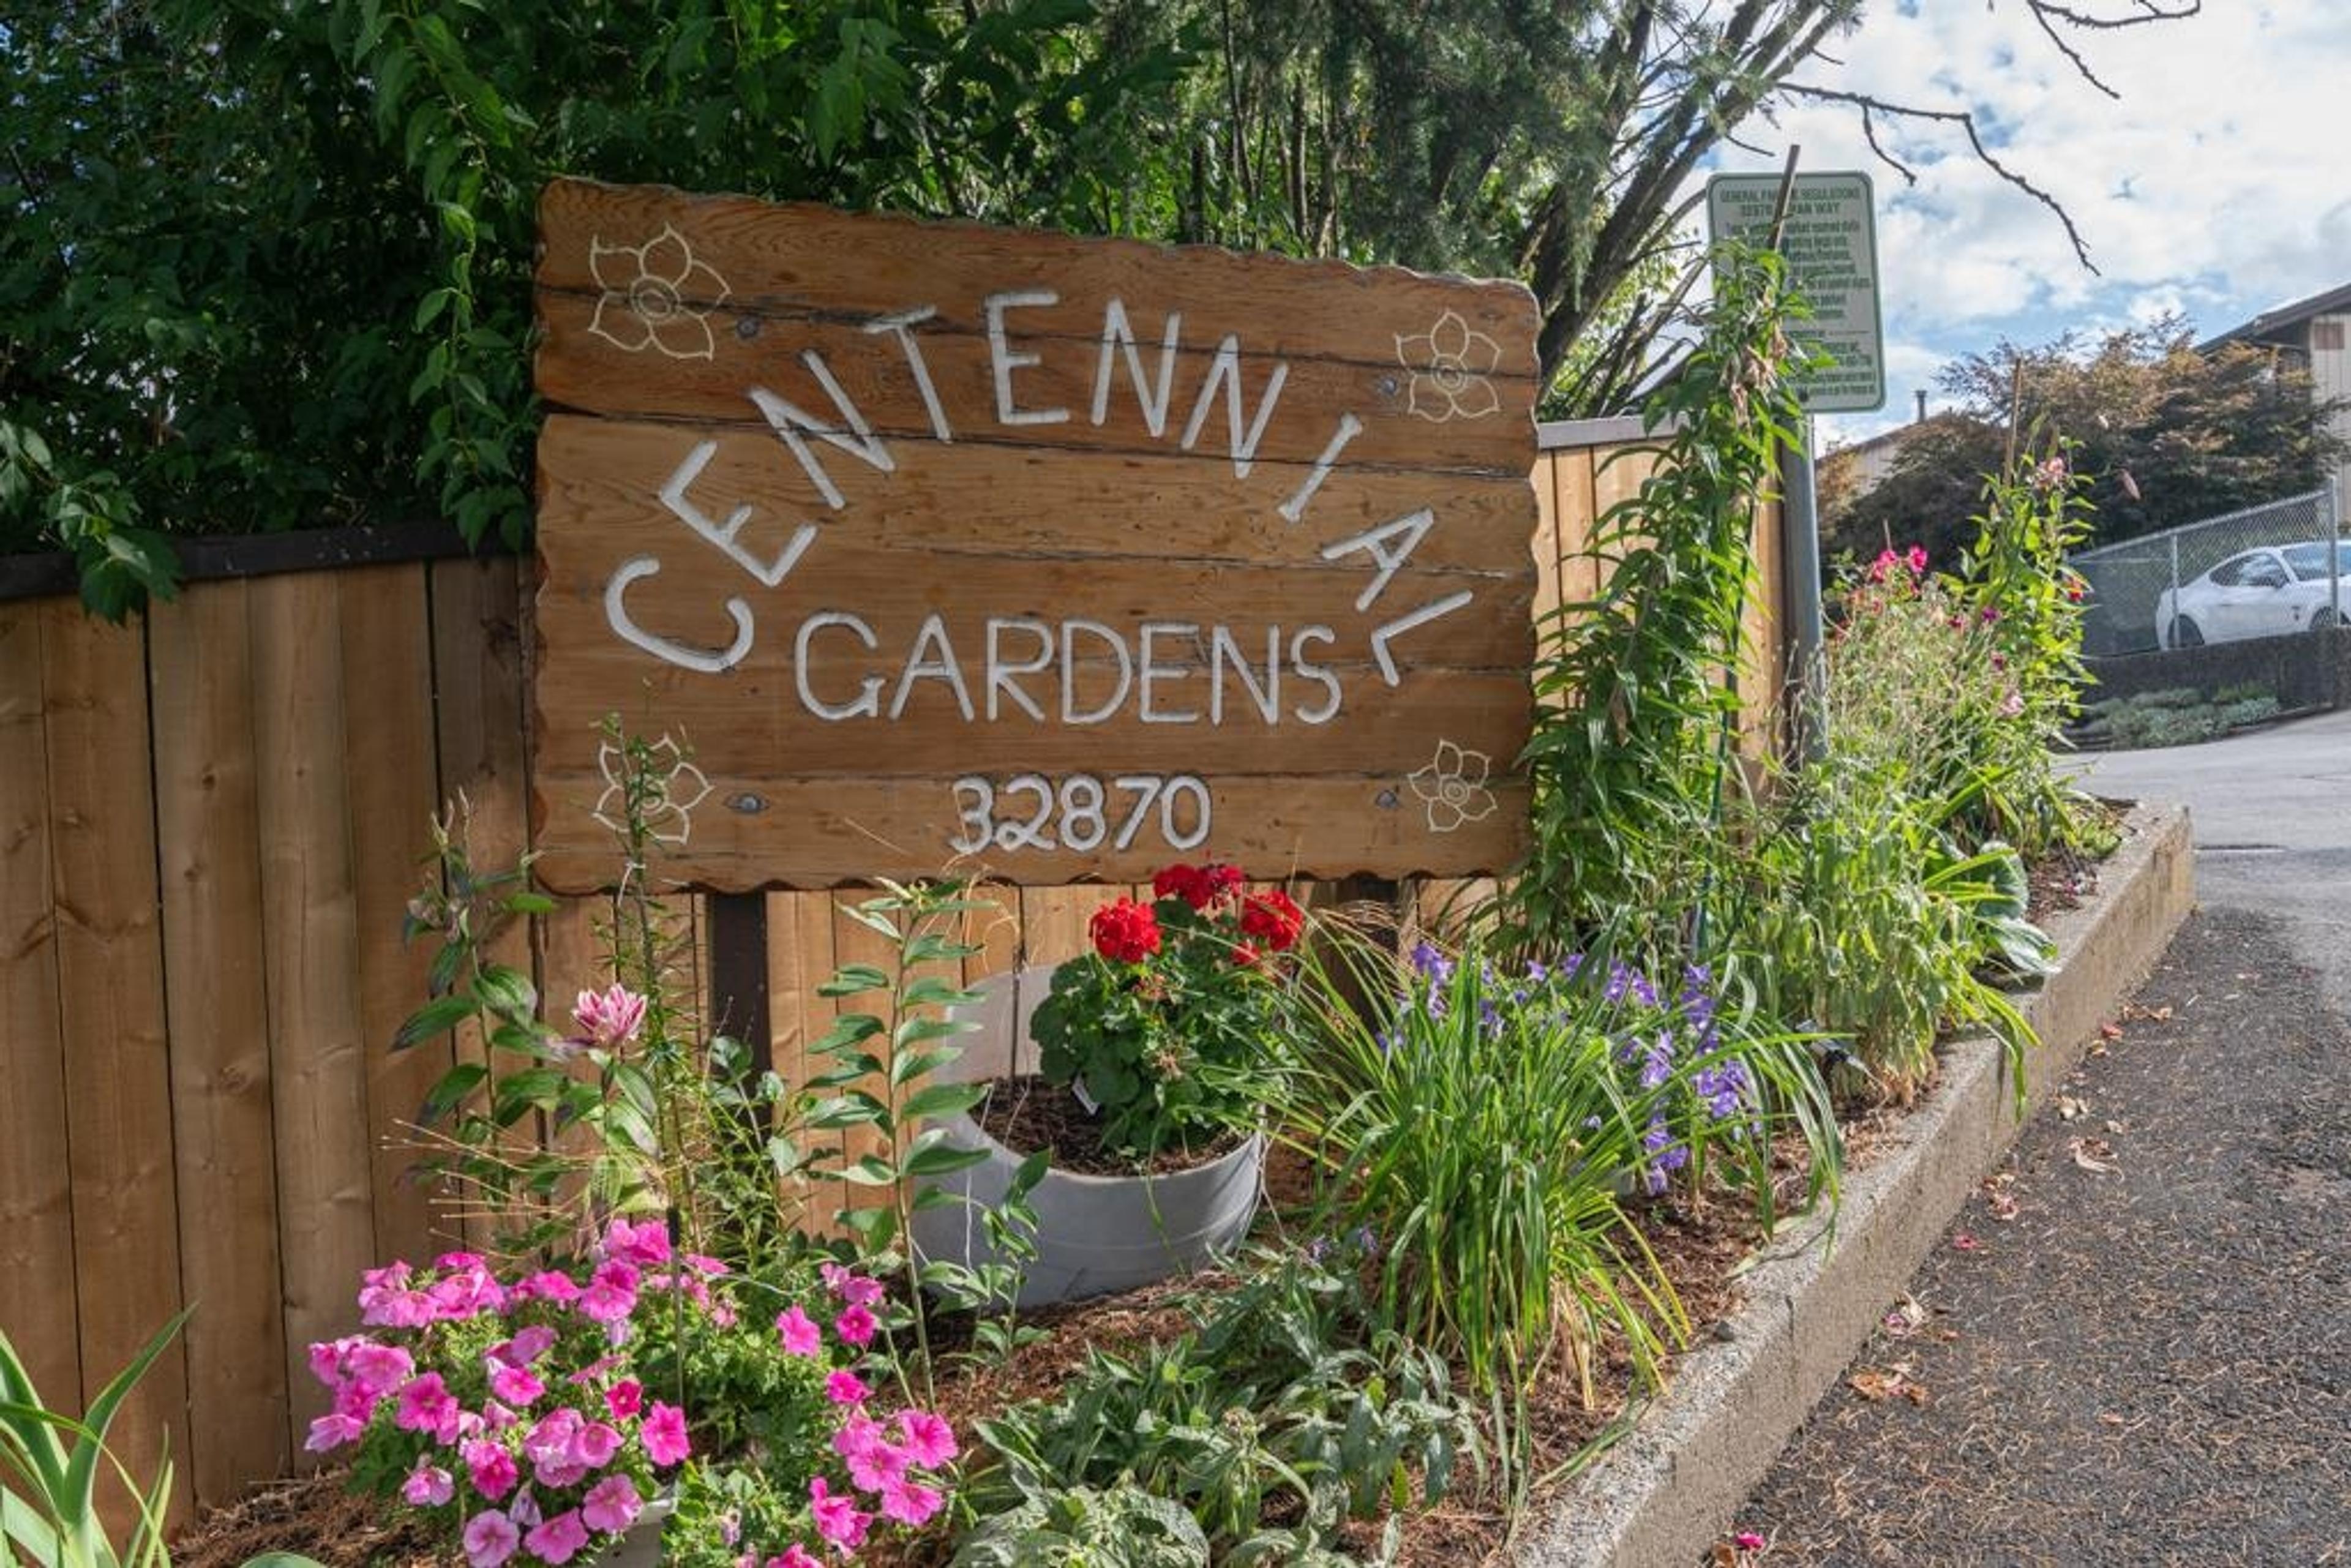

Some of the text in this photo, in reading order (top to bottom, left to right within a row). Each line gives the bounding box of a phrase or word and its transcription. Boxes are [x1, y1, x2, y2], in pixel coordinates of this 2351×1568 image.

[1719, 189, 1759, 203] GENERAL
[1814, 201, 1840, 214] WAY
[605, 290, 1473, 687] CENTENNIAL
[795, 613, 1343, 725] GARDENS
[950, 775, 1212, 855] 32870
